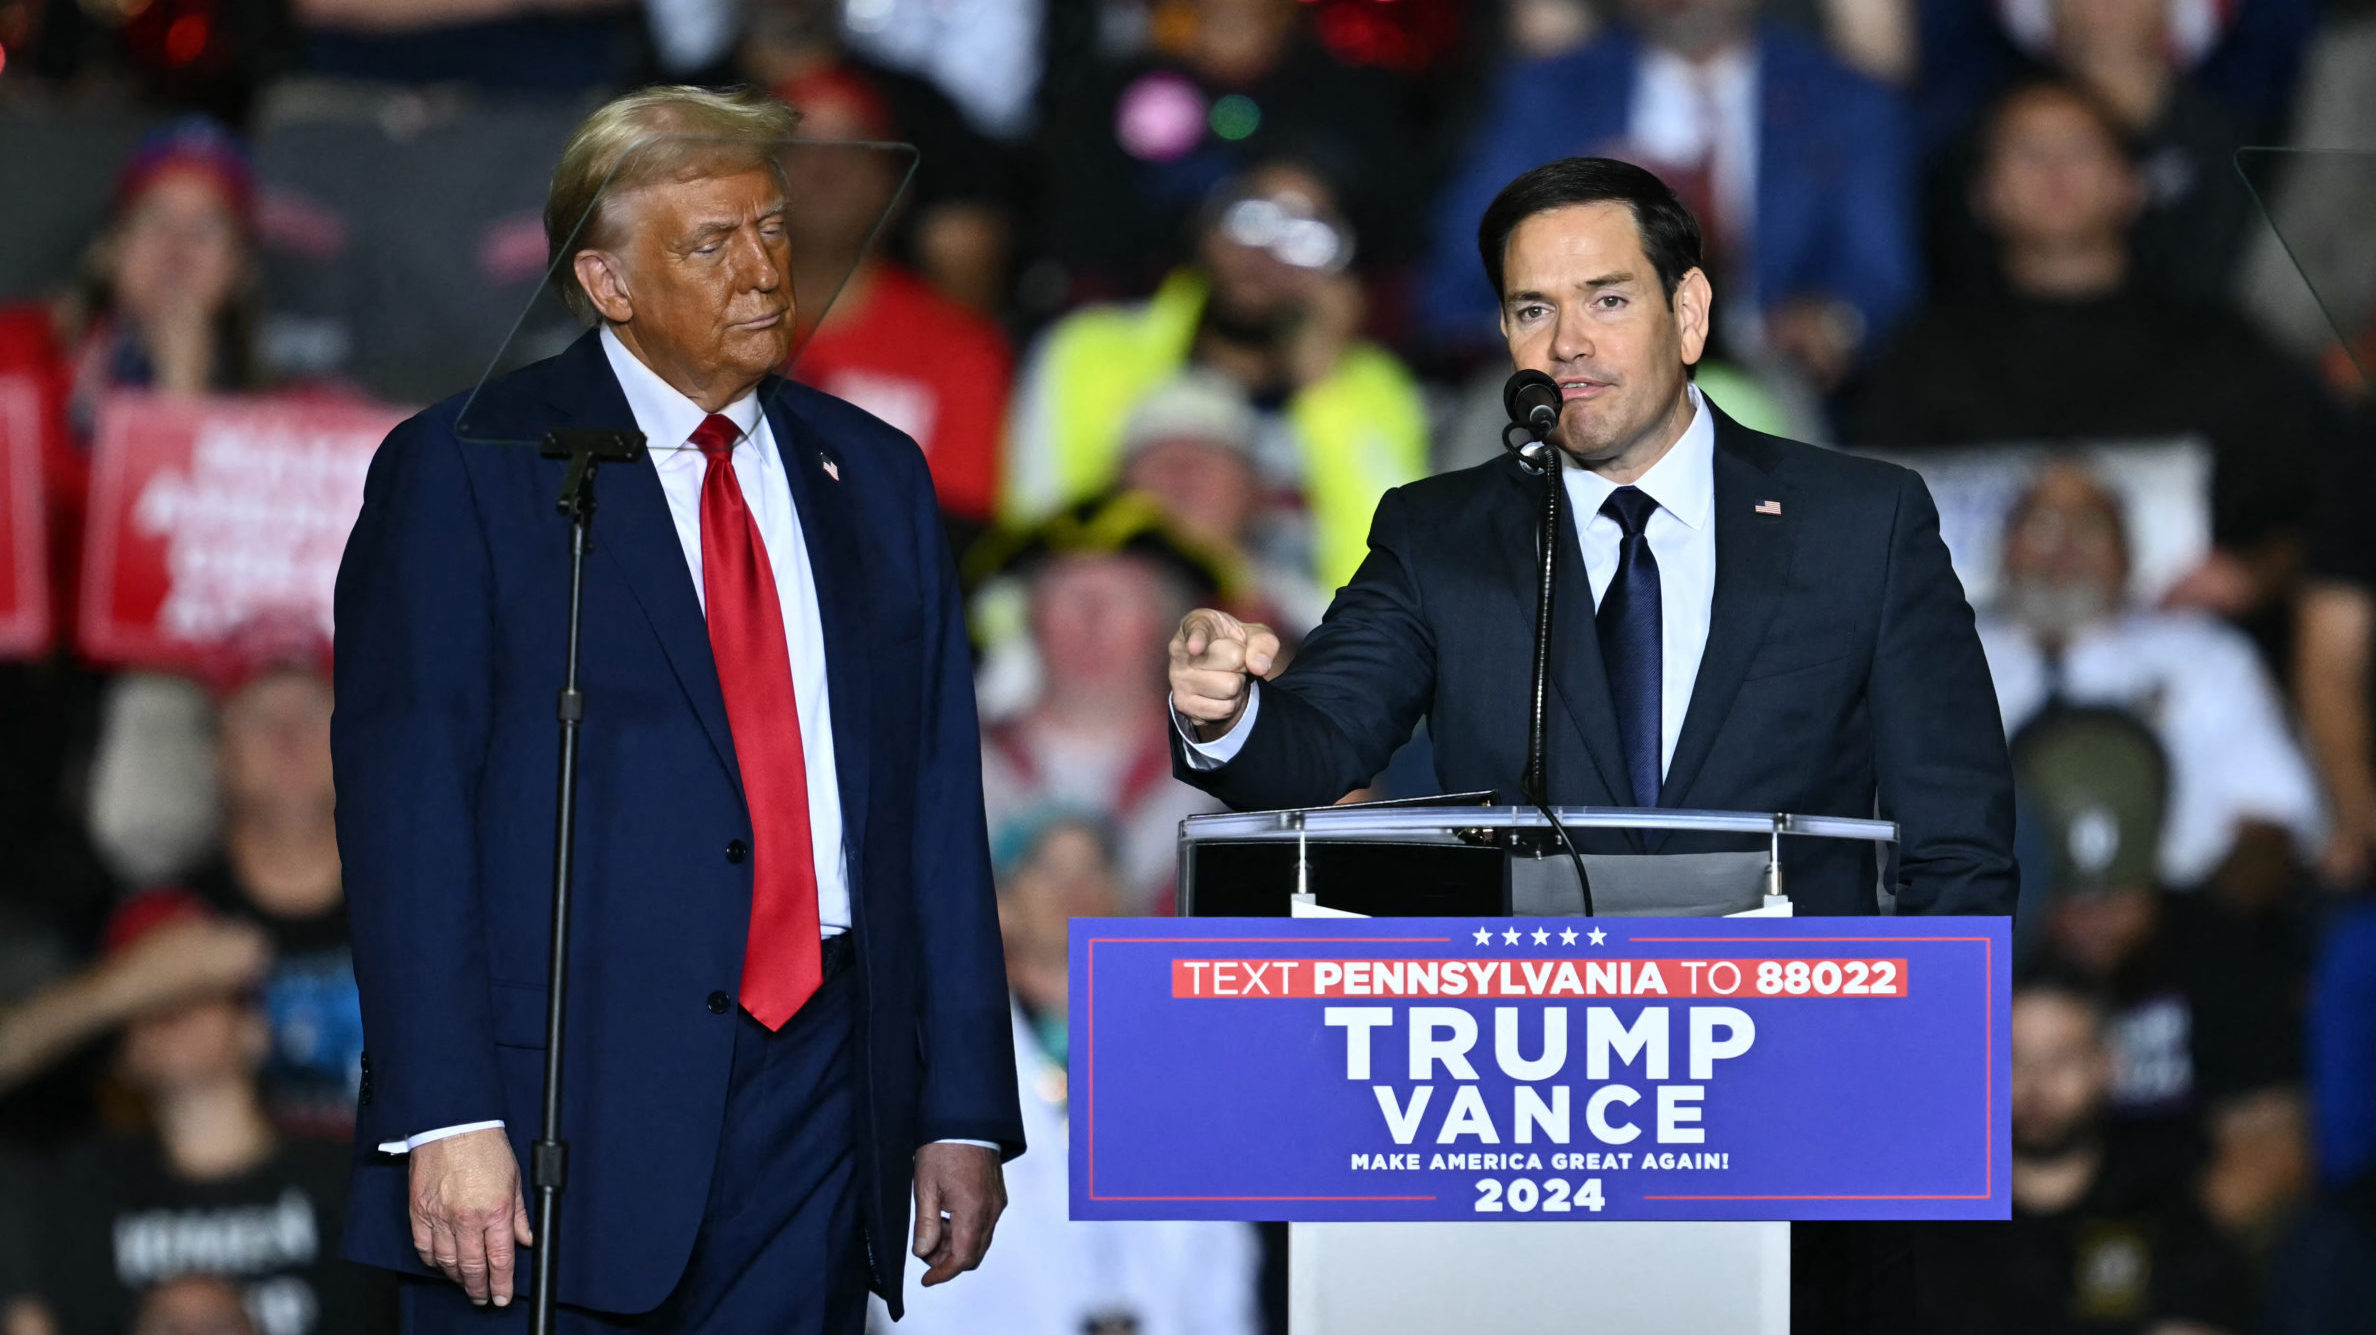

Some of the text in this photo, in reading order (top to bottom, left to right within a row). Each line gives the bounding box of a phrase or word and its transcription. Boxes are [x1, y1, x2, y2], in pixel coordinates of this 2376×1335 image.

[1184, 960, 1897, 996] TEXT PENNSYLVANIA TO 88022
[1324, 1006, 1756, 1081] TRUMP
[1373, 1085, 1705, 1145] VANCE
[1351, 1152, 1729, 1170] MAKE AMERICA GREAT AGAIN!
[1474, 1178, 1605, 1212] 2024
